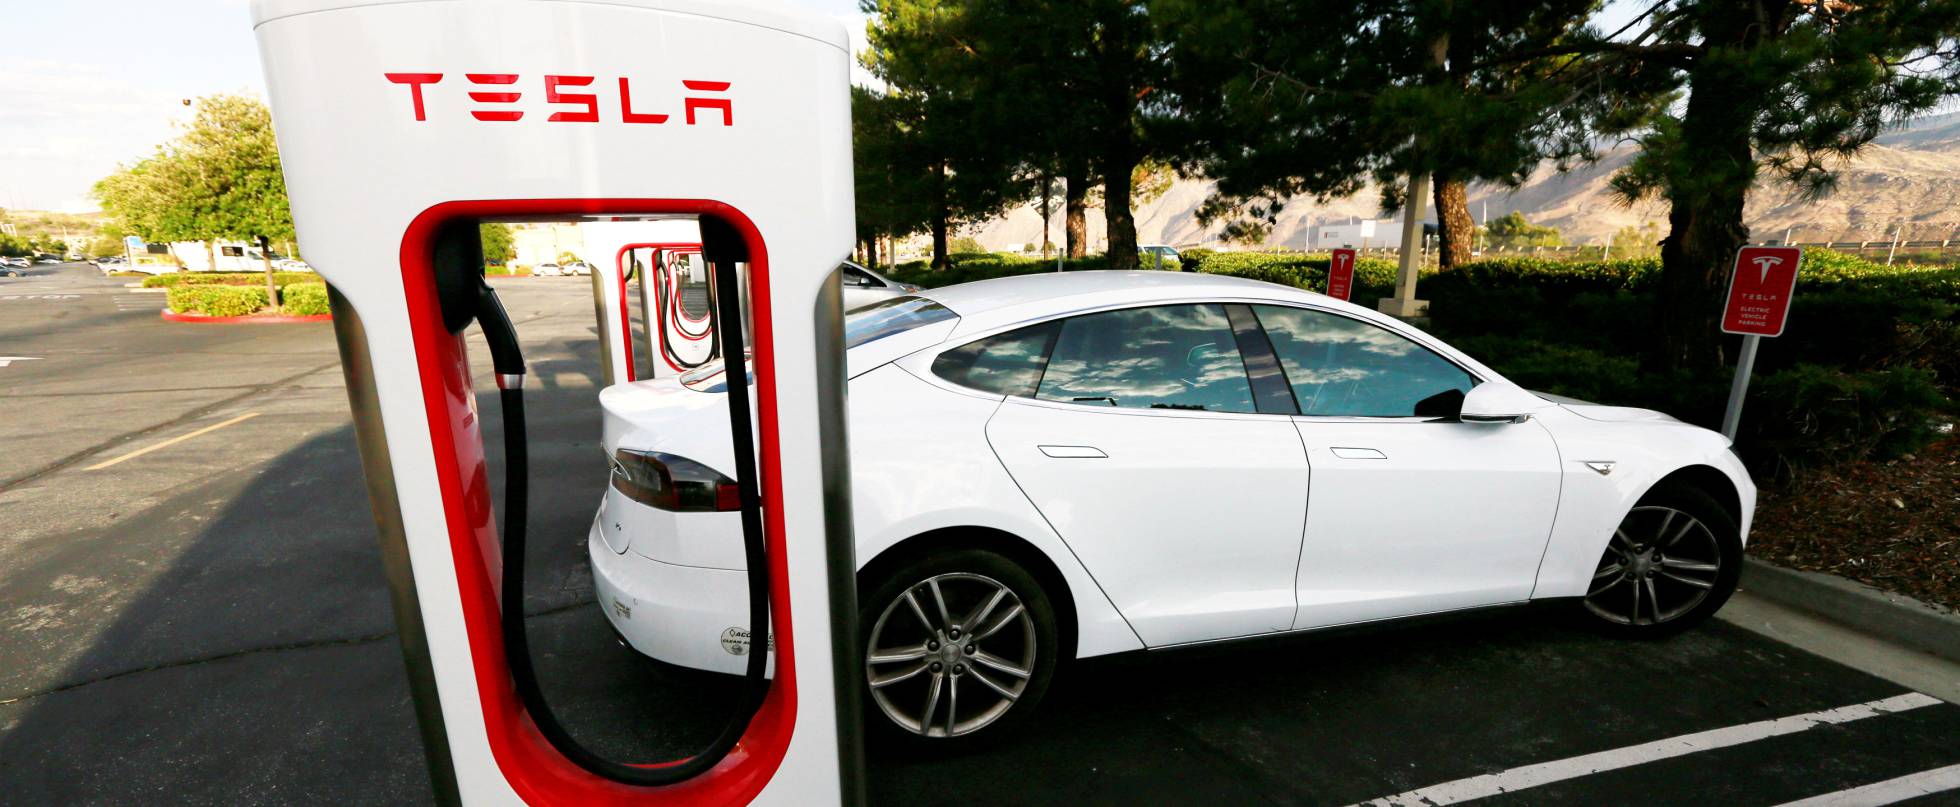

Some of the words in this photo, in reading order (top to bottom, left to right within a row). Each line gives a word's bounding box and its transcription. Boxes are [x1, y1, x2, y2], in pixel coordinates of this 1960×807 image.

[384, 72, 733, 126] TESLA
[1742, 293, 1776, 301] TESLA
[1738, 319, 1767, 327] PARKING
